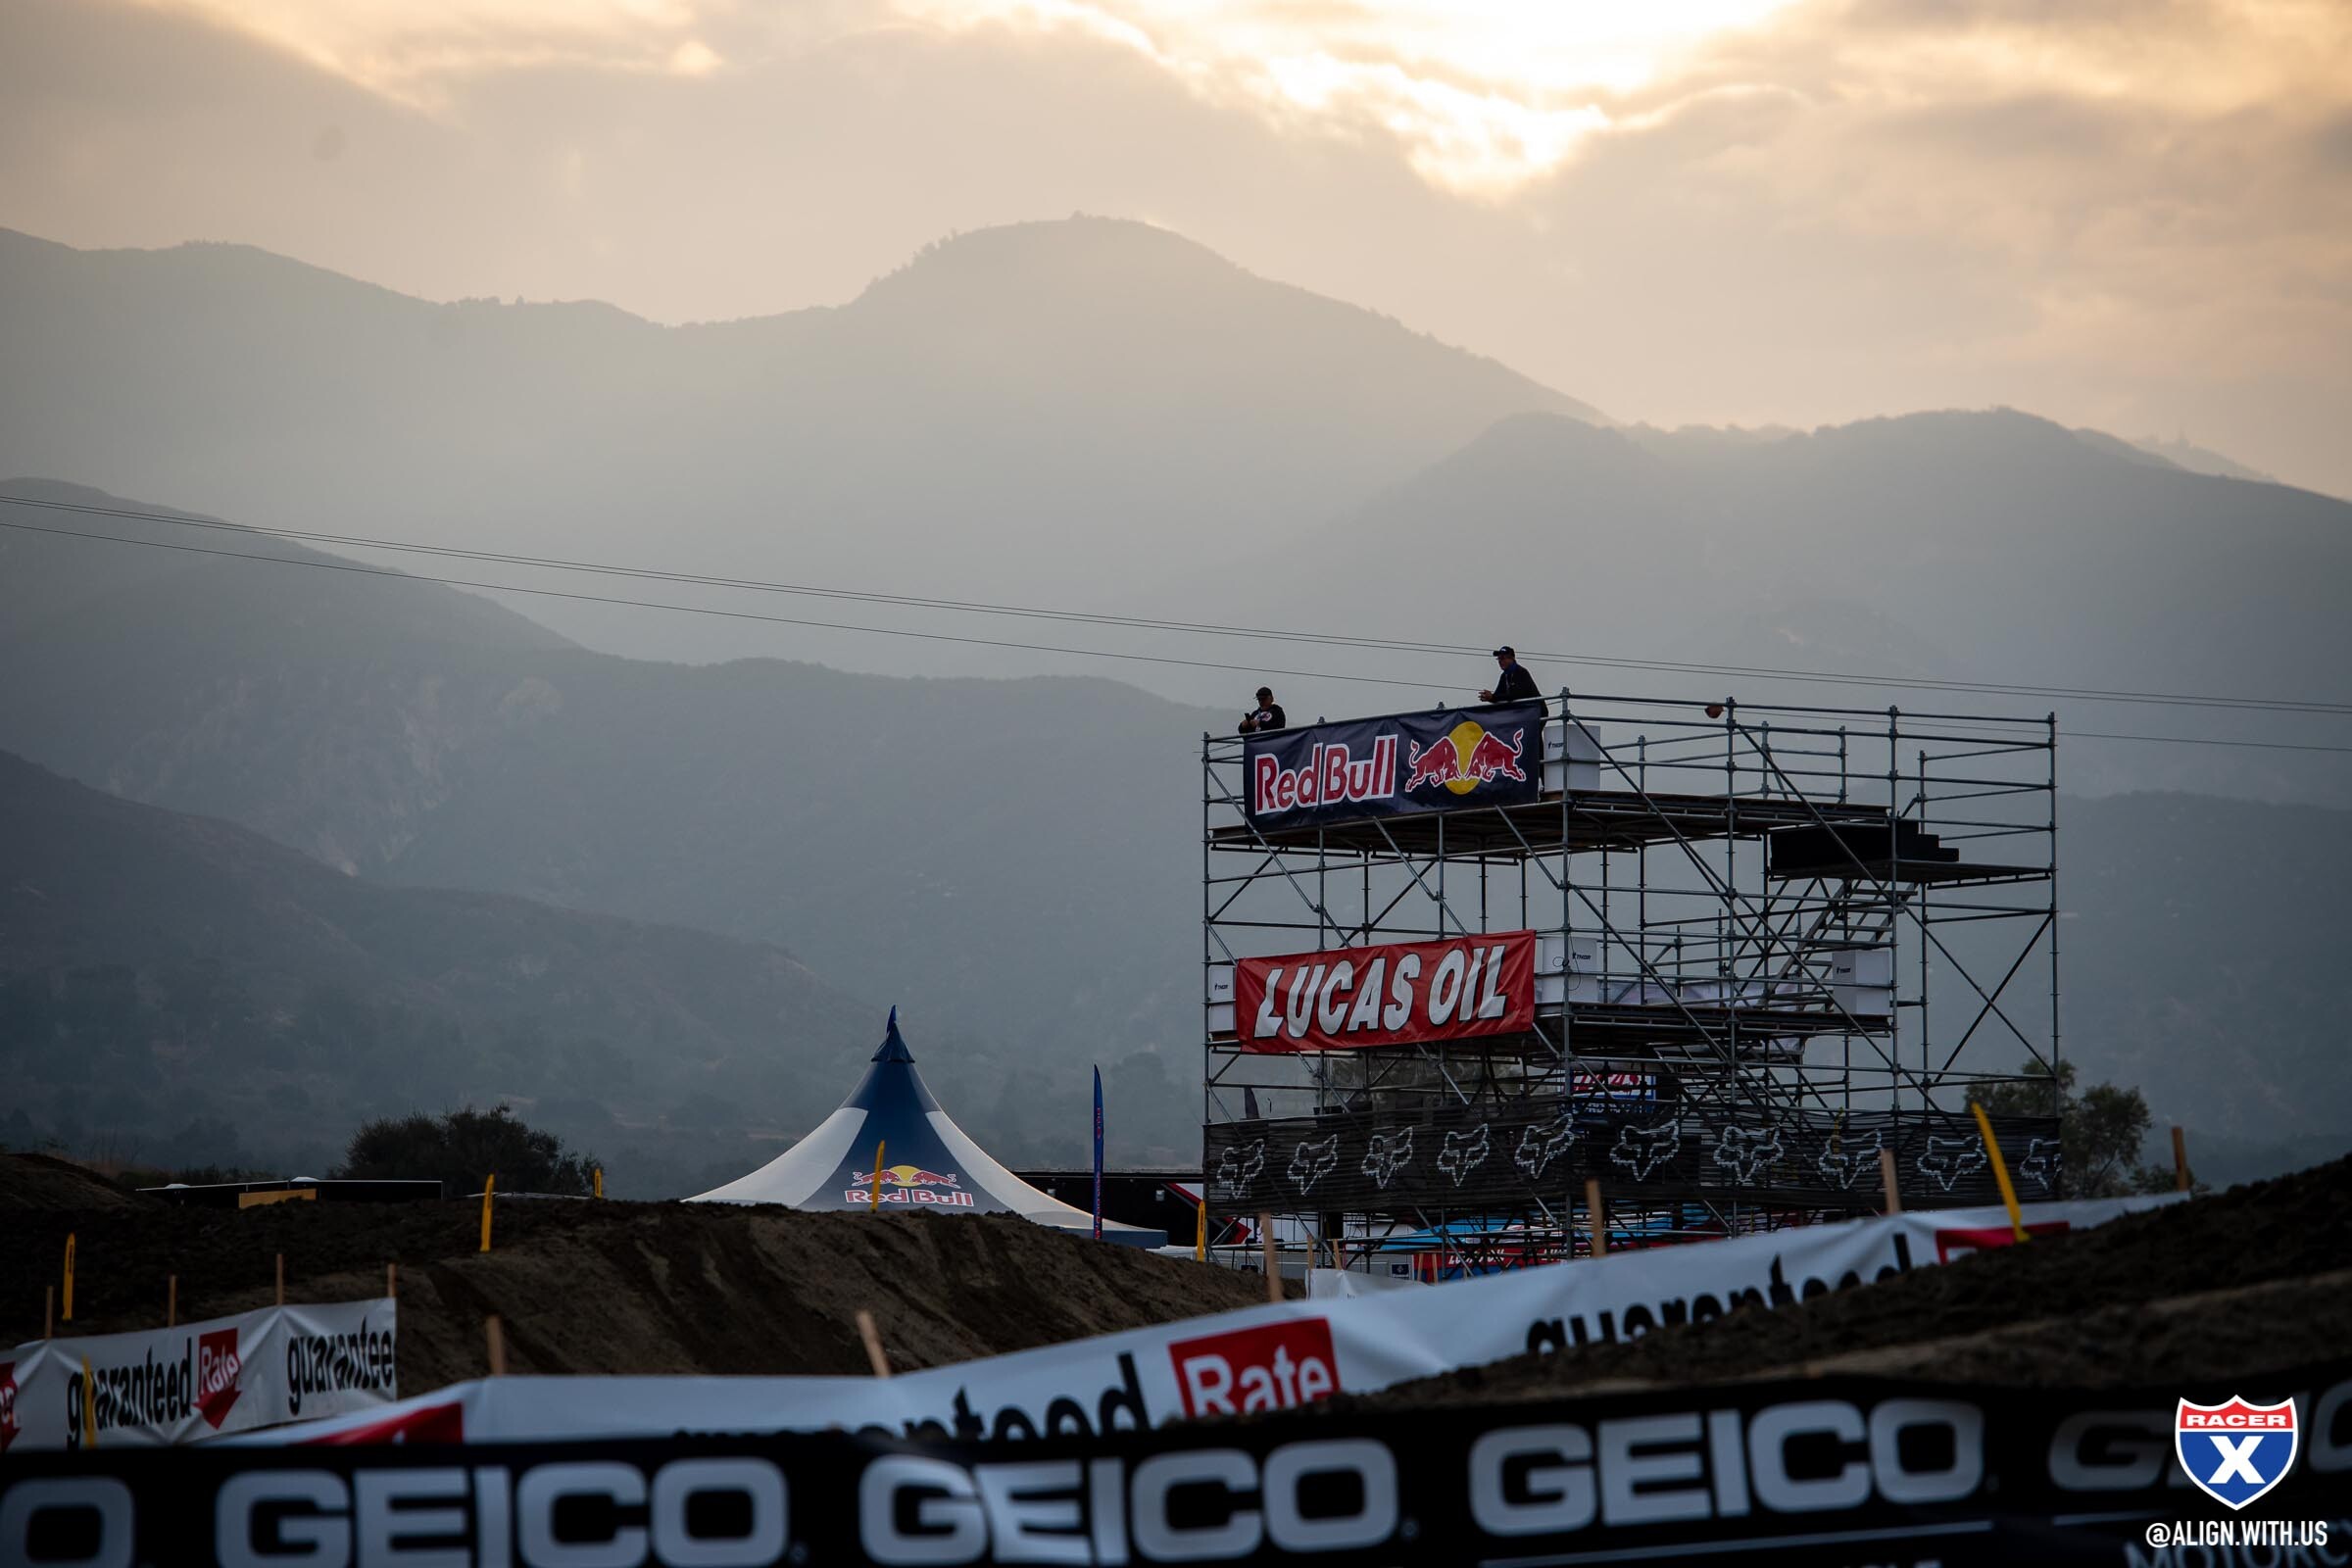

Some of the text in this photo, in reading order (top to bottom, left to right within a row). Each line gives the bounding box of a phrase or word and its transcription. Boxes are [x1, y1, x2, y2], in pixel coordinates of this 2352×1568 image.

[1253, 944, 1507, 1039] LUCAS OIL
[844, 1188, 974, 1206] Red Bull
[287, 1315, 393, 1415] guarantee
[1182, 1348, 1335, 1420] Rate
[213, 1456, 790, 1568] GEICO
[858, 1437, 1401, 1567] GEICO
[1468, 1398, 1985, 1537] GEICO
